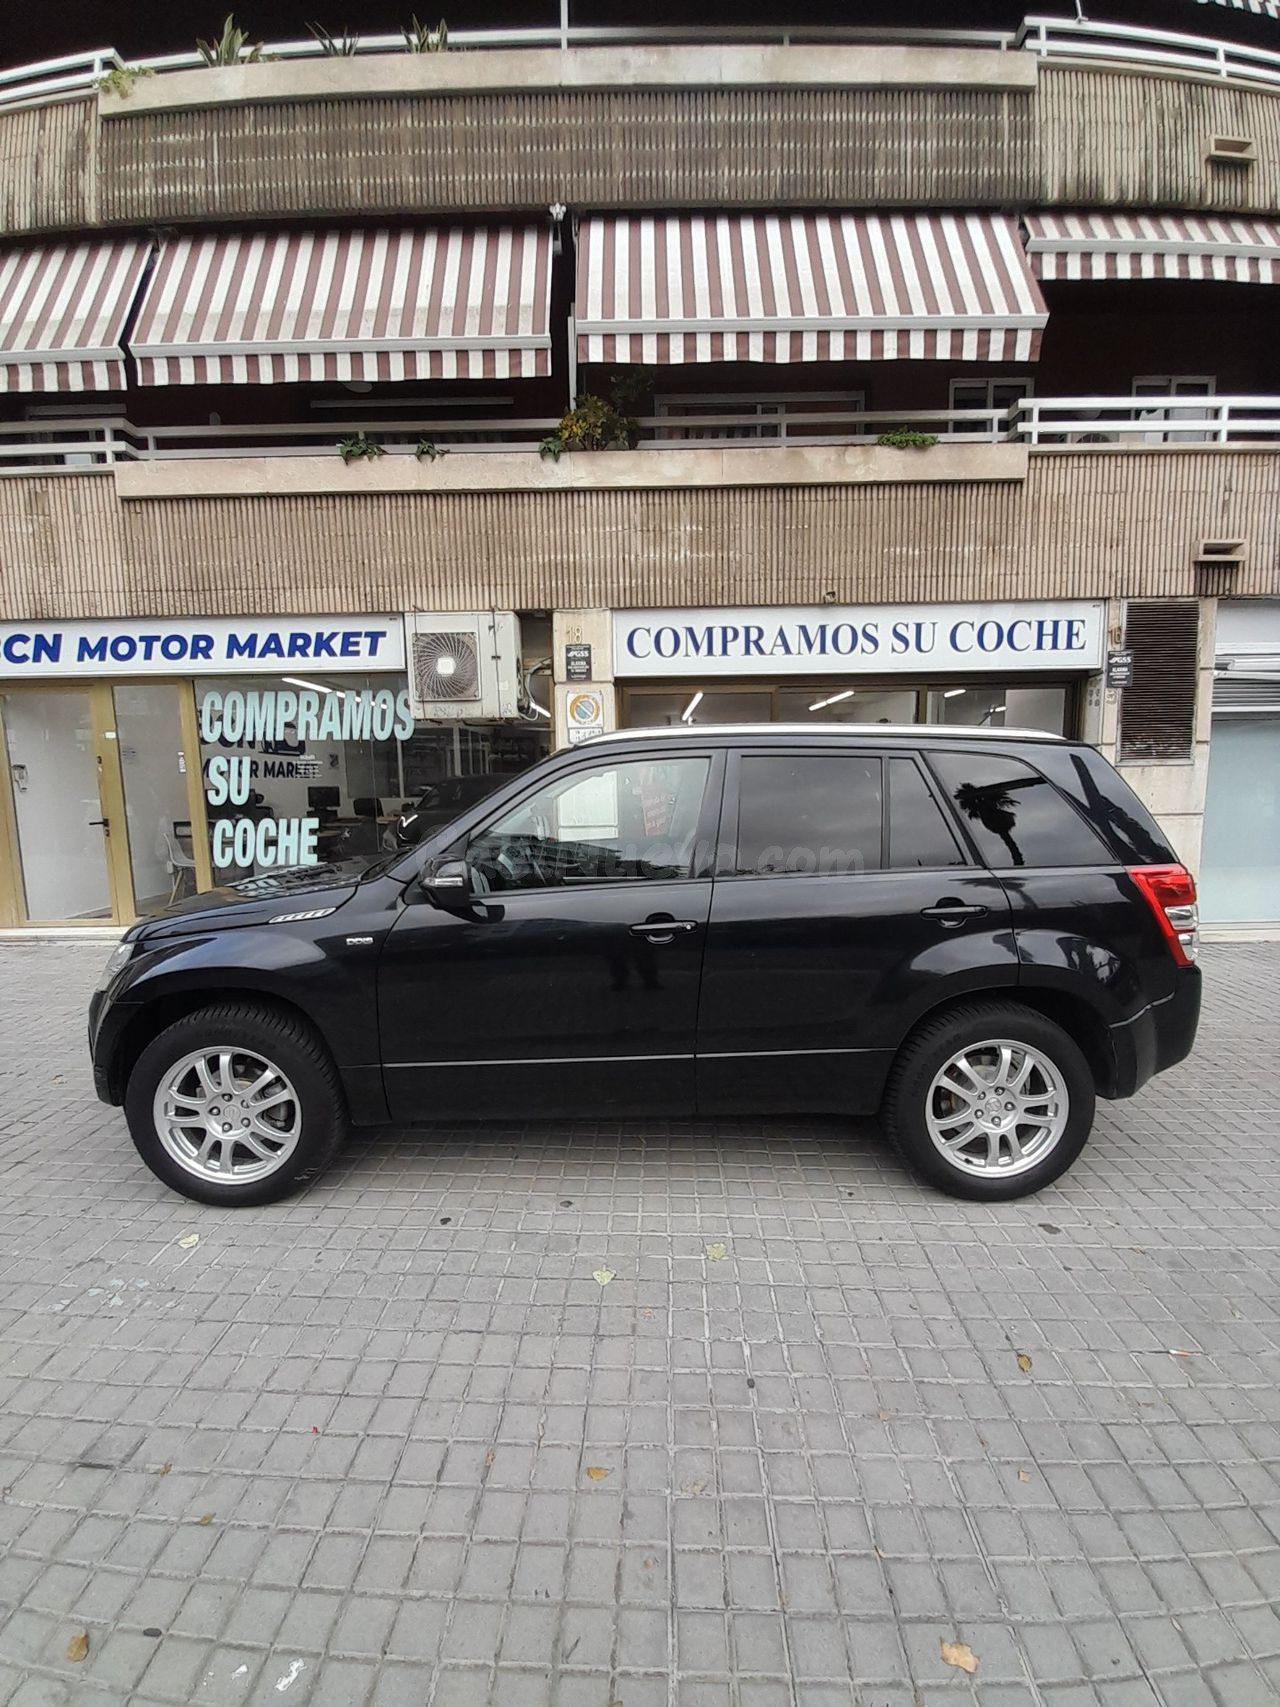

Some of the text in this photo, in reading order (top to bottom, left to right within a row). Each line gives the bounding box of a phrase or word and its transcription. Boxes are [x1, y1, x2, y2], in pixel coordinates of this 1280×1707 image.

[0, 631, 387, 665] CN MOTOR MARKET
[626, 617, 1088, 659] COMPRAMOS SU COCHE
[200, 688, 415, 742] COMPRAMOS
[206, 755, 252, 807] SU
[212, 817, 320, 868] COCHE
